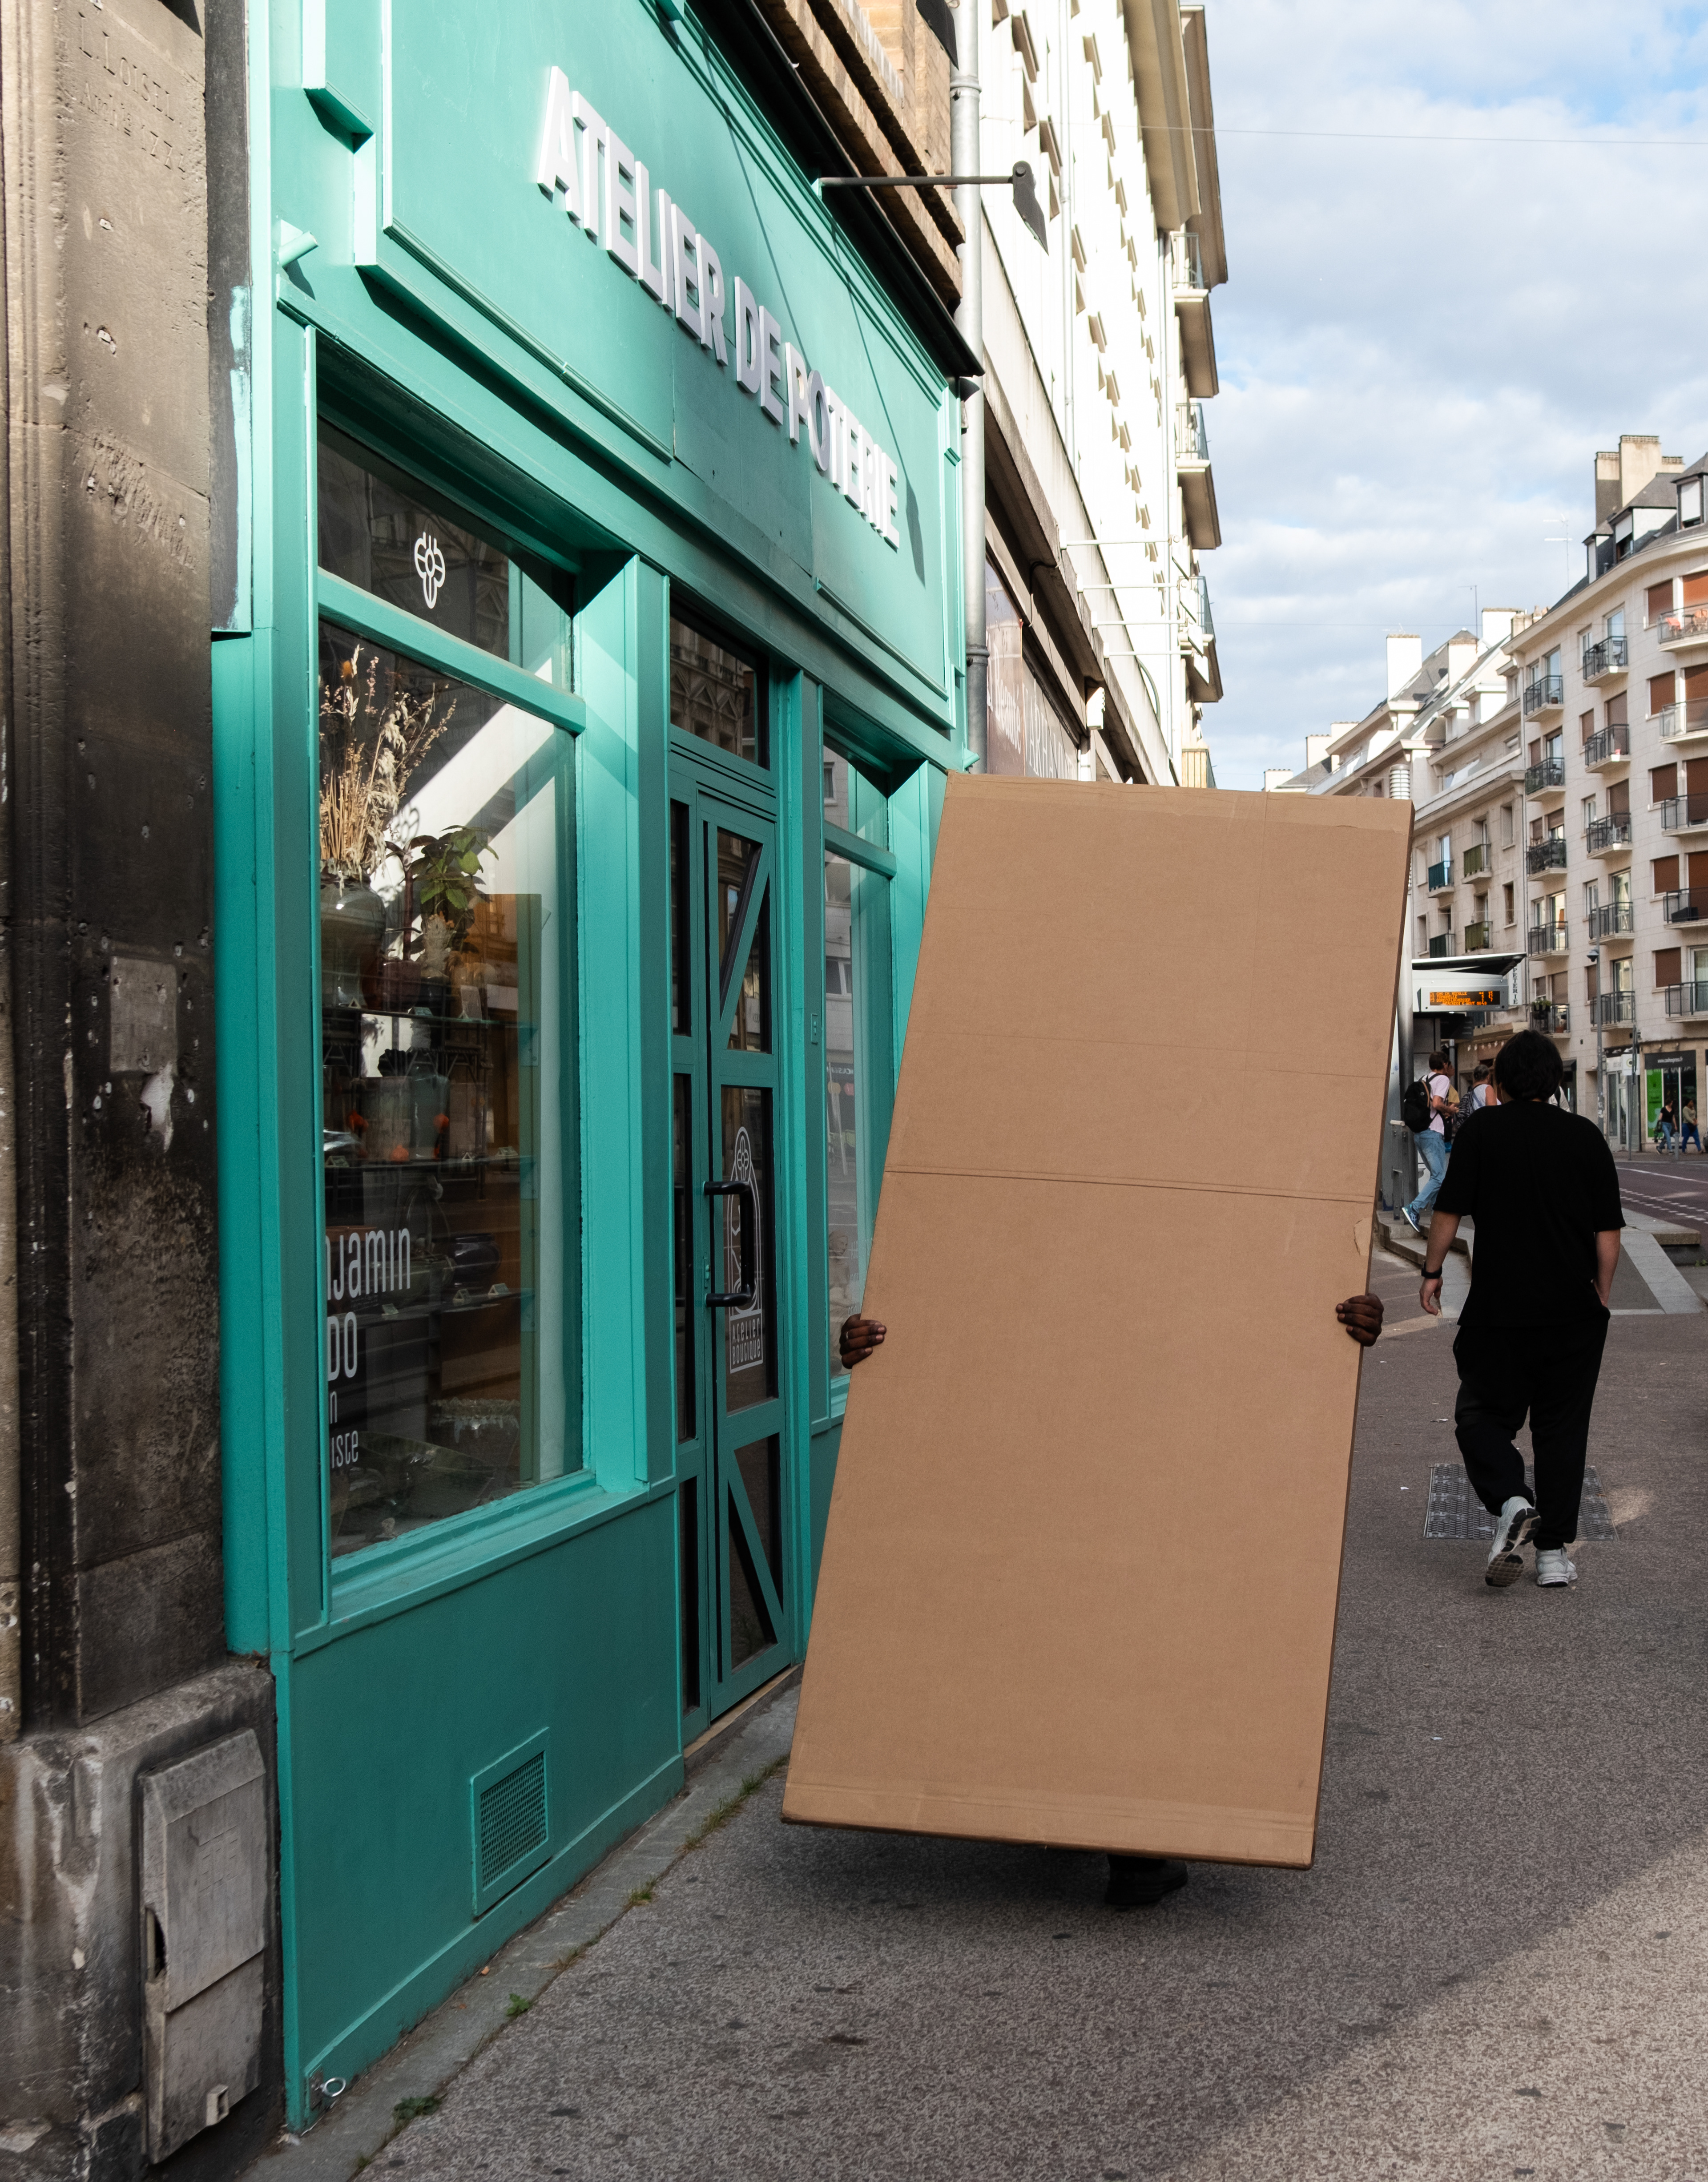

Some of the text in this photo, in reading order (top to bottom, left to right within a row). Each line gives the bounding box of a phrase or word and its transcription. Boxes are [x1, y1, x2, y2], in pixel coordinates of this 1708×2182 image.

[536, 65, 900, 552] ATELIER DE POTERIE
[993, 642, 1022, 755] Beauté
